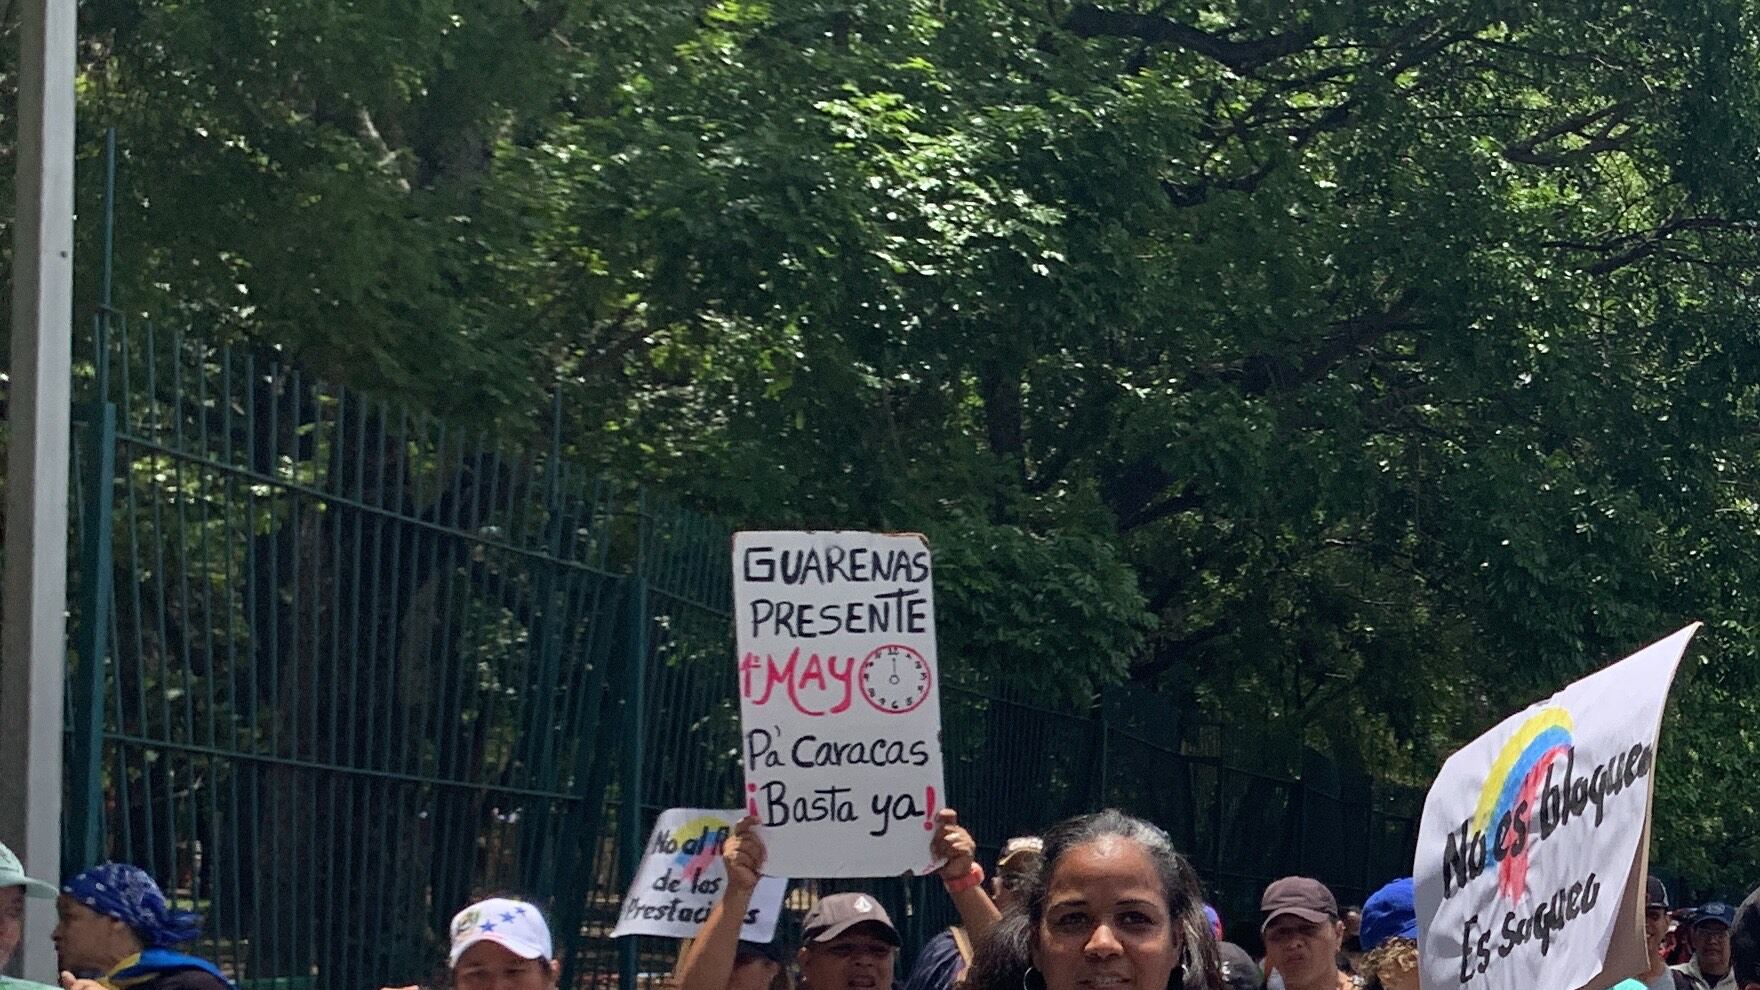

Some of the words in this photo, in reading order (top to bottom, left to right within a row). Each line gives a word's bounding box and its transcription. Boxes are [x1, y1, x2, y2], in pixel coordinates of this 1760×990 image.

[743, 546, 929, 584] GUARENAS
[751, 589, 927, 638] PRESENTE
[792, 735, 929, 768] Caracas
[652, 829, 678, 855] No
[682, 826, 709, 855] al
[1443, 818, 1487, 900] No
[1493, 799, 1529, 862] es
[652, 868, 682, 893] de
[1460, 913, 1492, 984] Es
[1498, 872, 1600, 958] Saqueo
